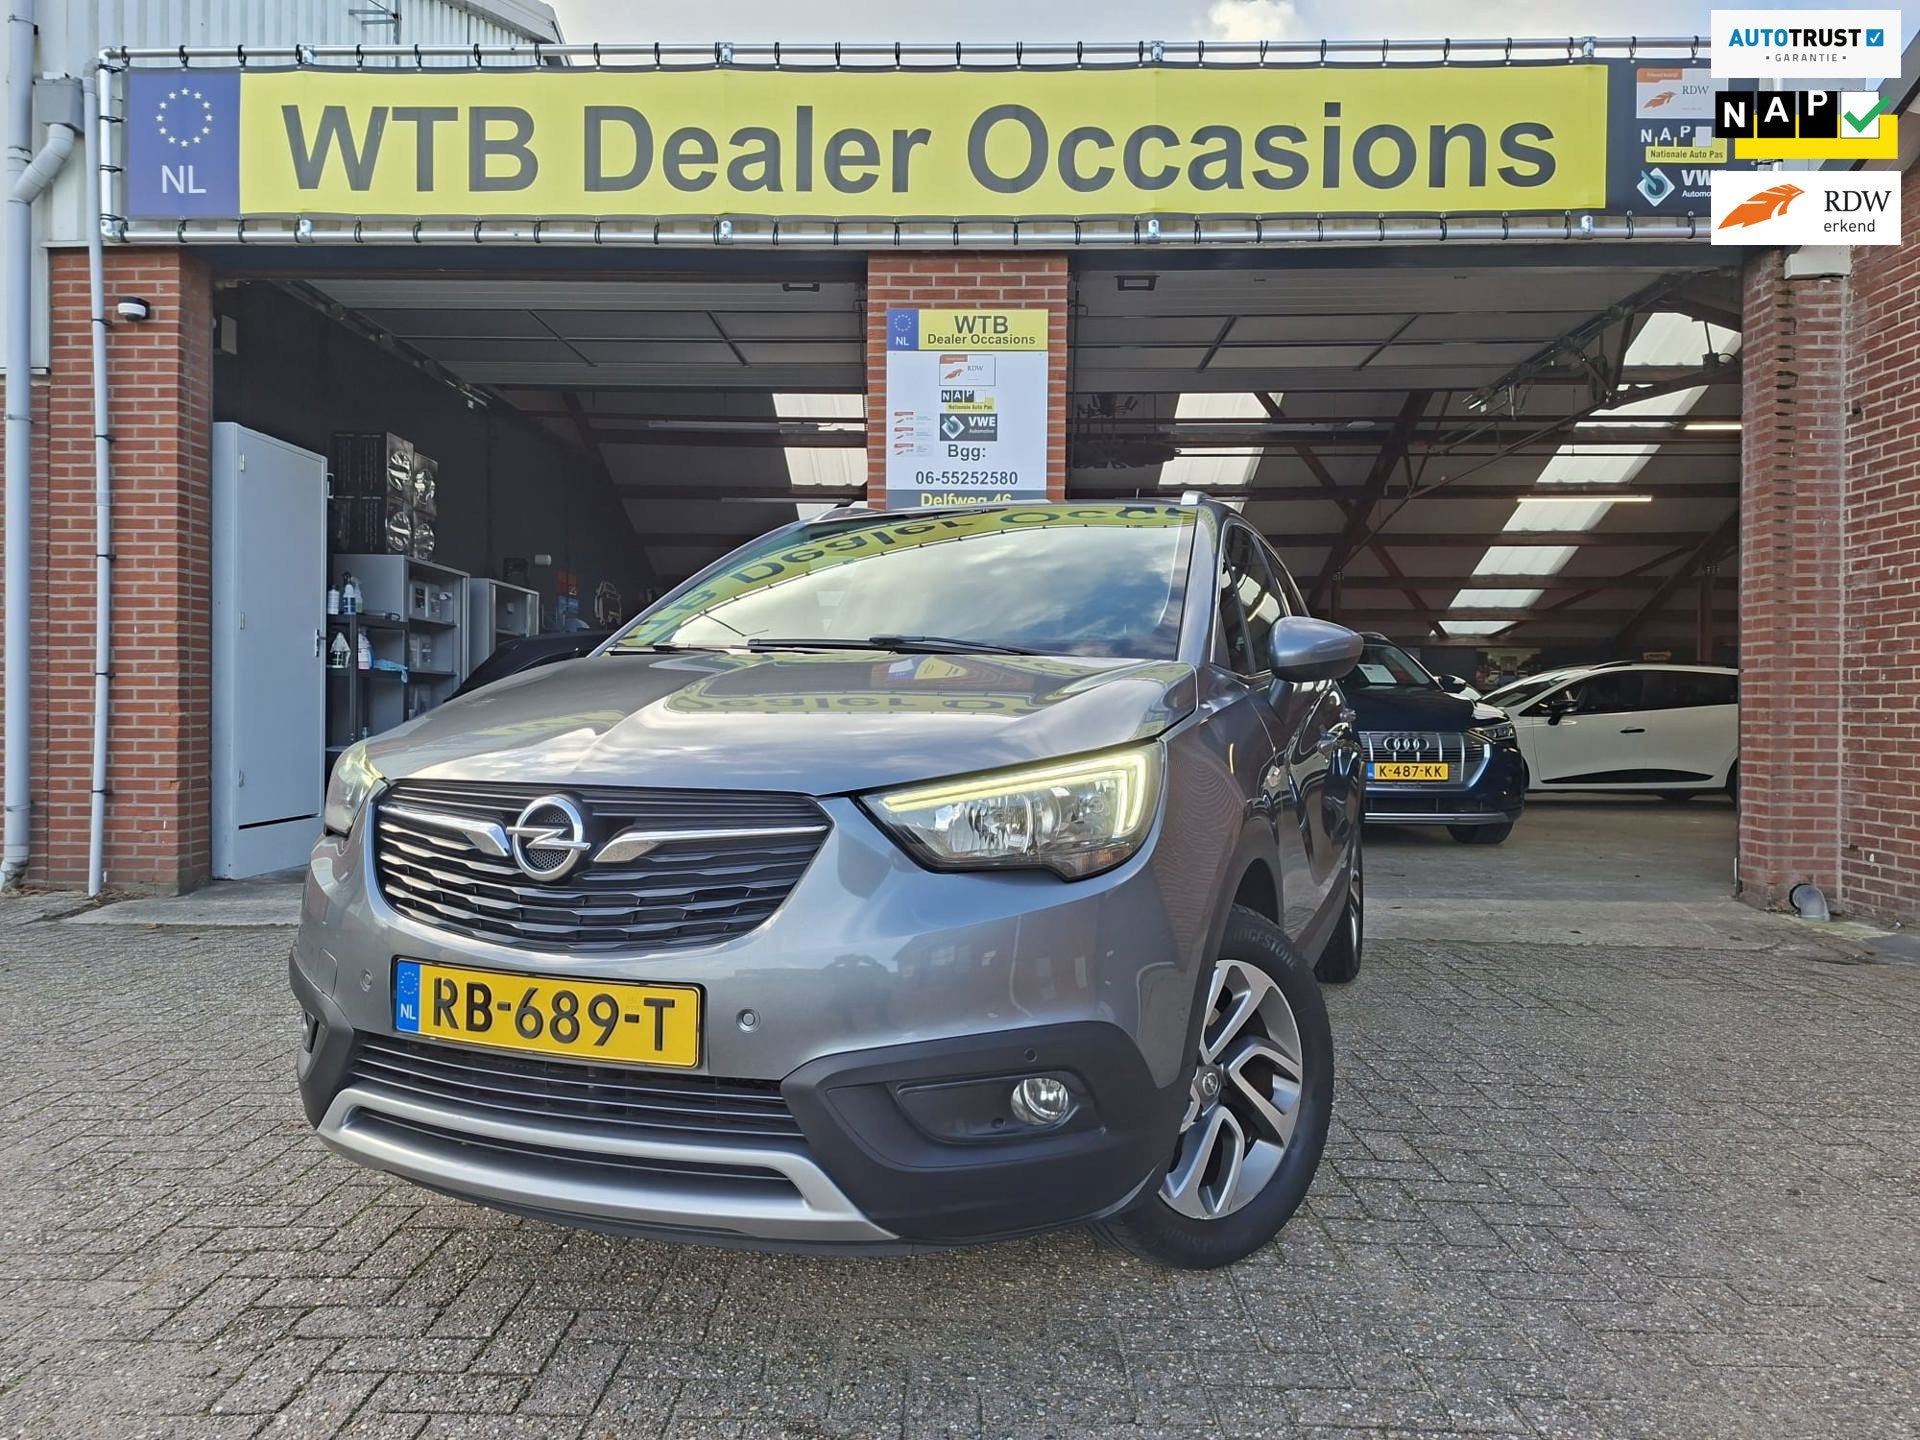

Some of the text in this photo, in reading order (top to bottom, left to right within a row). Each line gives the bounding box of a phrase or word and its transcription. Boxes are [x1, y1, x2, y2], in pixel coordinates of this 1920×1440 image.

[1682, 85, 1710, 96] RDW
[281, 101, 1557, 193] WTB Dealer Occasions
[1650, 149, 1724, 159] Nationale Auto Pas
[161, 164, 206, 195] NL
[1681, 169, 1712, 187] VW
[1682, 189, 1712, 198] Automo
[954, 315, 1009, 334] WTB
[895, 336, 910, 346] NL
[927, 334, 1036, 345] Dealer Occasions
[968, 416, 996, 427] VWE
[947, 444, 986, 461] Bgg:
[915, 471, 1018, 485] 06-55252580
[1379, 766, 1442, 777] K-487-KK
[400, 1003, 416, 1021] NL
[432, 977, 676, 1051] RB-689-T
